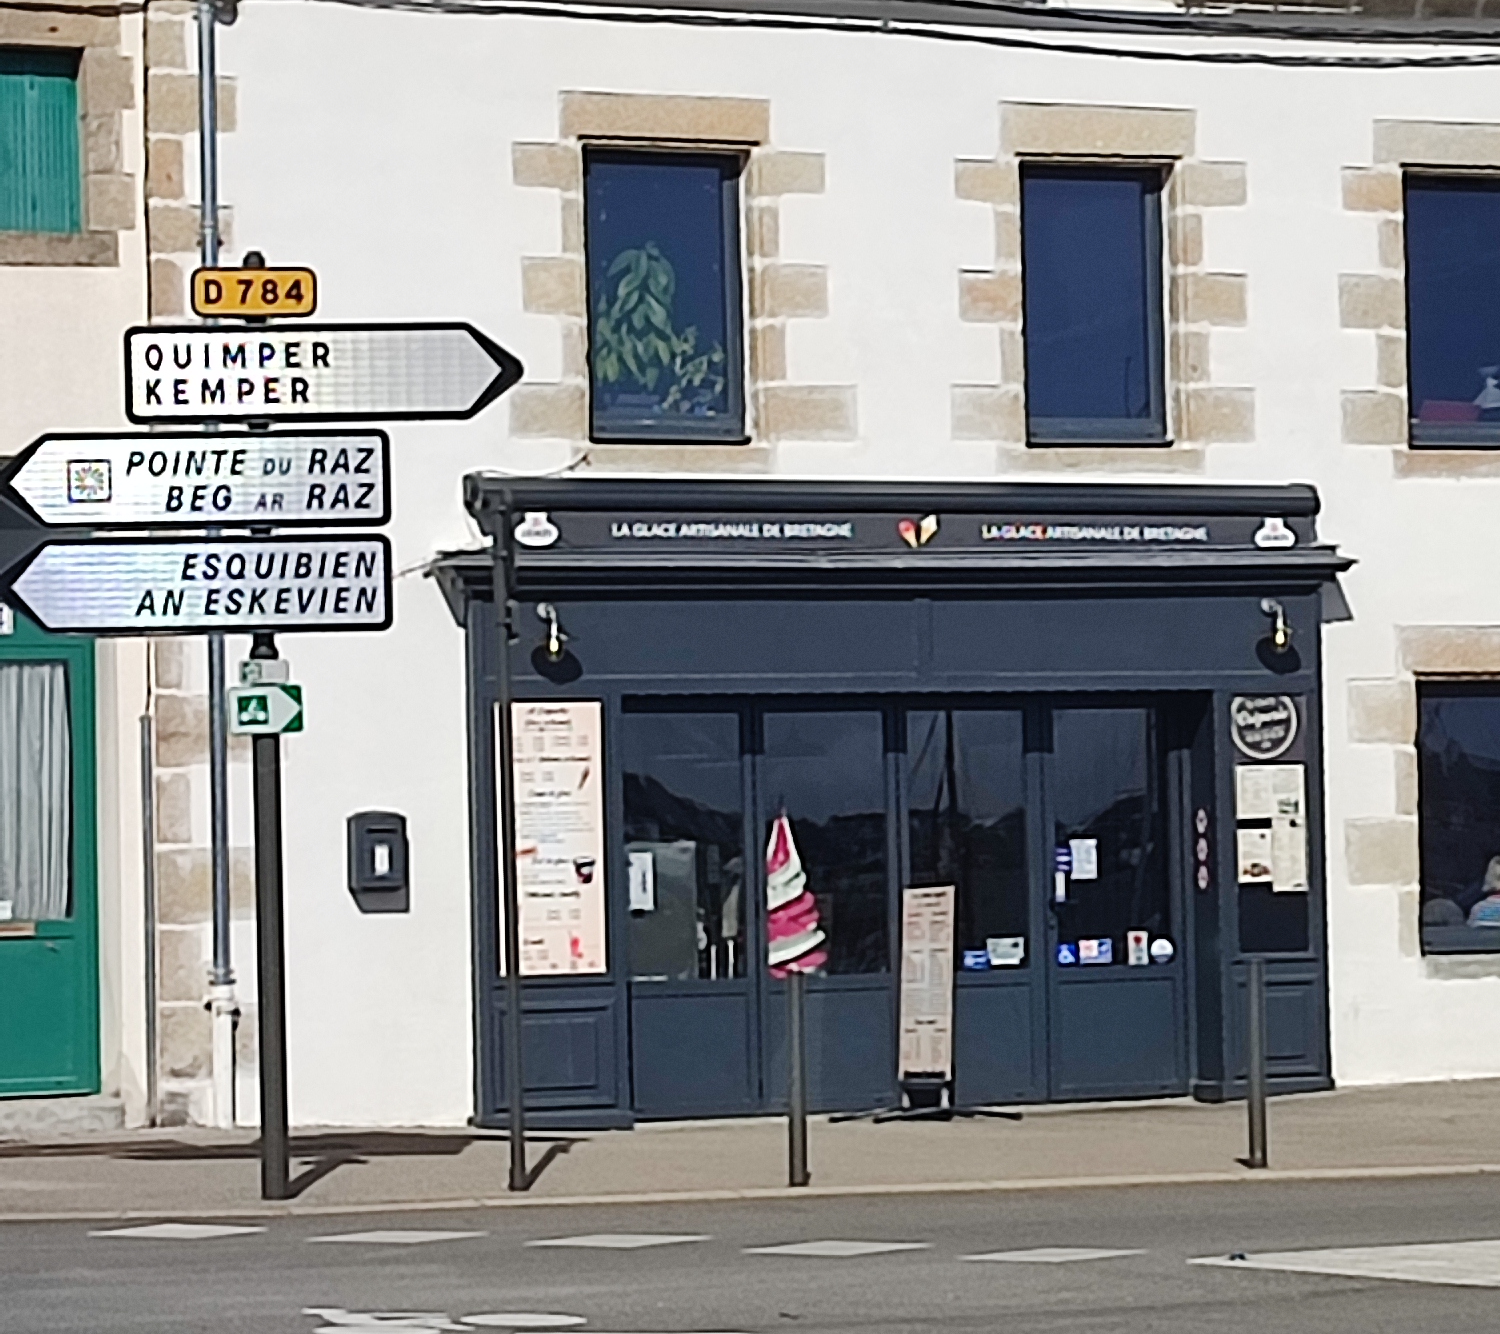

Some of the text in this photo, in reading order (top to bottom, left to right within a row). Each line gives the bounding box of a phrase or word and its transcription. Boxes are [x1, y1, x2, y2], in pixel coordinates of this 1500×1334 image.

[203, 278, 305, 306] D 784
[144, 341, 330, 370] QUIMPER
[145, 376, 310, 405] KEMPER
[126, 447, 375, 477] POINTE DU RAZ
[165, 482, 376, 513] BEG AR RAZ
[611, 522, 630, 537] LA
[632, 522, 677, 538] GLACE
[181, 551, 377, 581] ESQUIBIEN
[135, 586, 378, 617] AN ESKEVIEN
